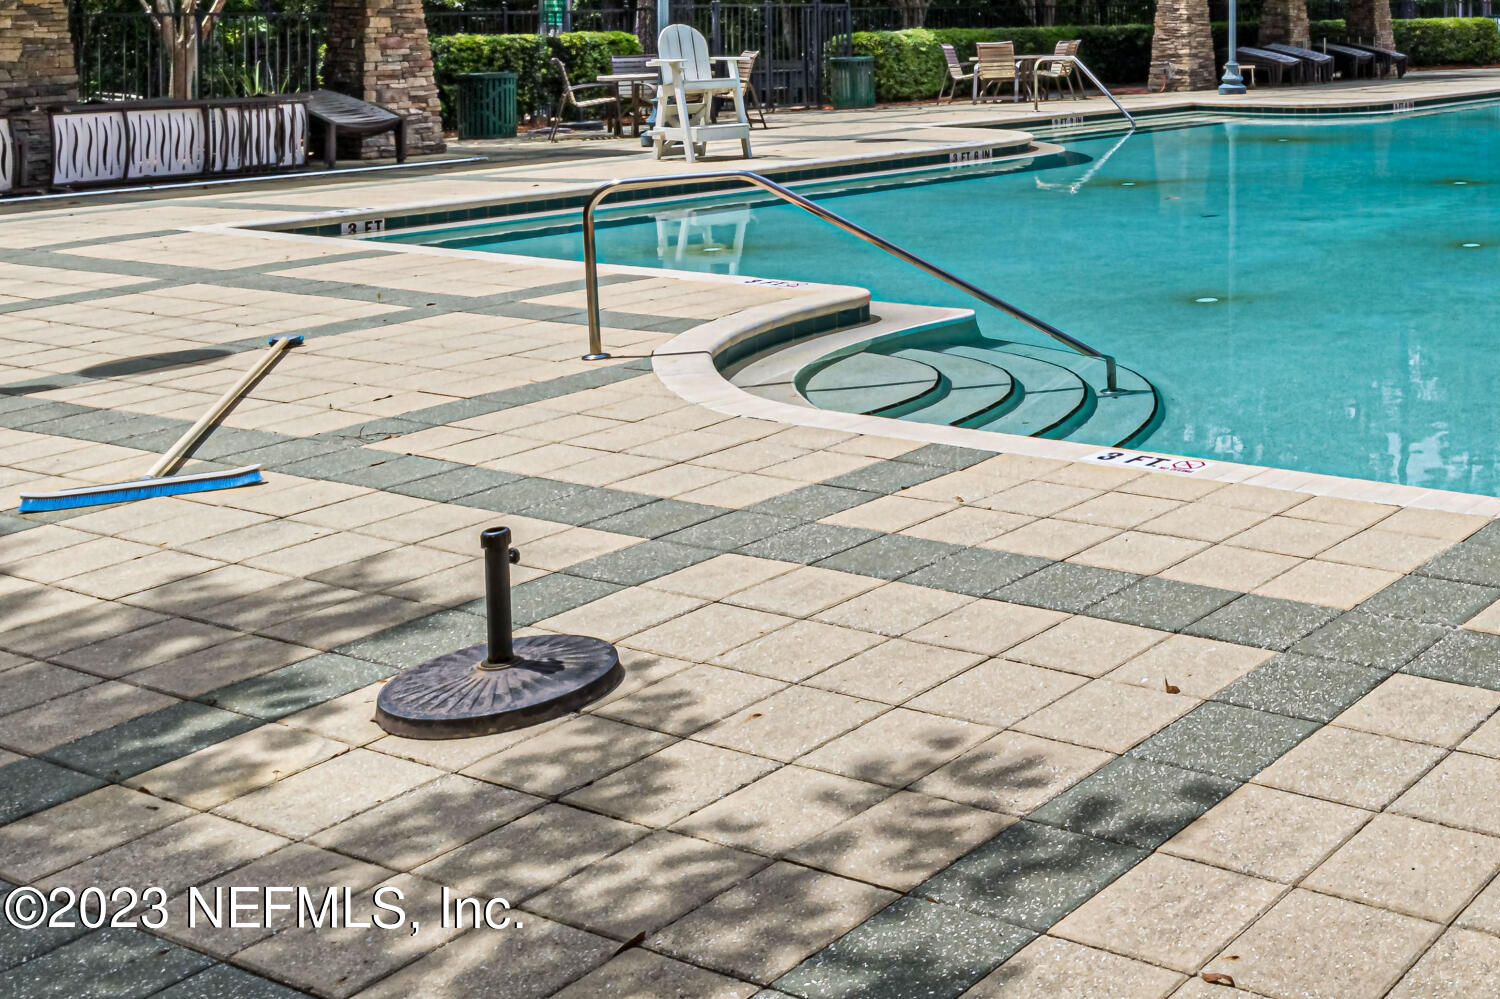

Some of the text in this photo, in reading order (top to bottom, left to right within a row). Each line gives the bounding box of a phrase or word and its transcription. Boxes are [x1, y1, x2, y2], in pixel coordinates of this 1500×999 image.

[961, 151, 970, 161] FT
[982, 149, 990, 159] IN
[348, 219, 383, 234] 3 FT
[1097, 451, 1124, 460] 3
